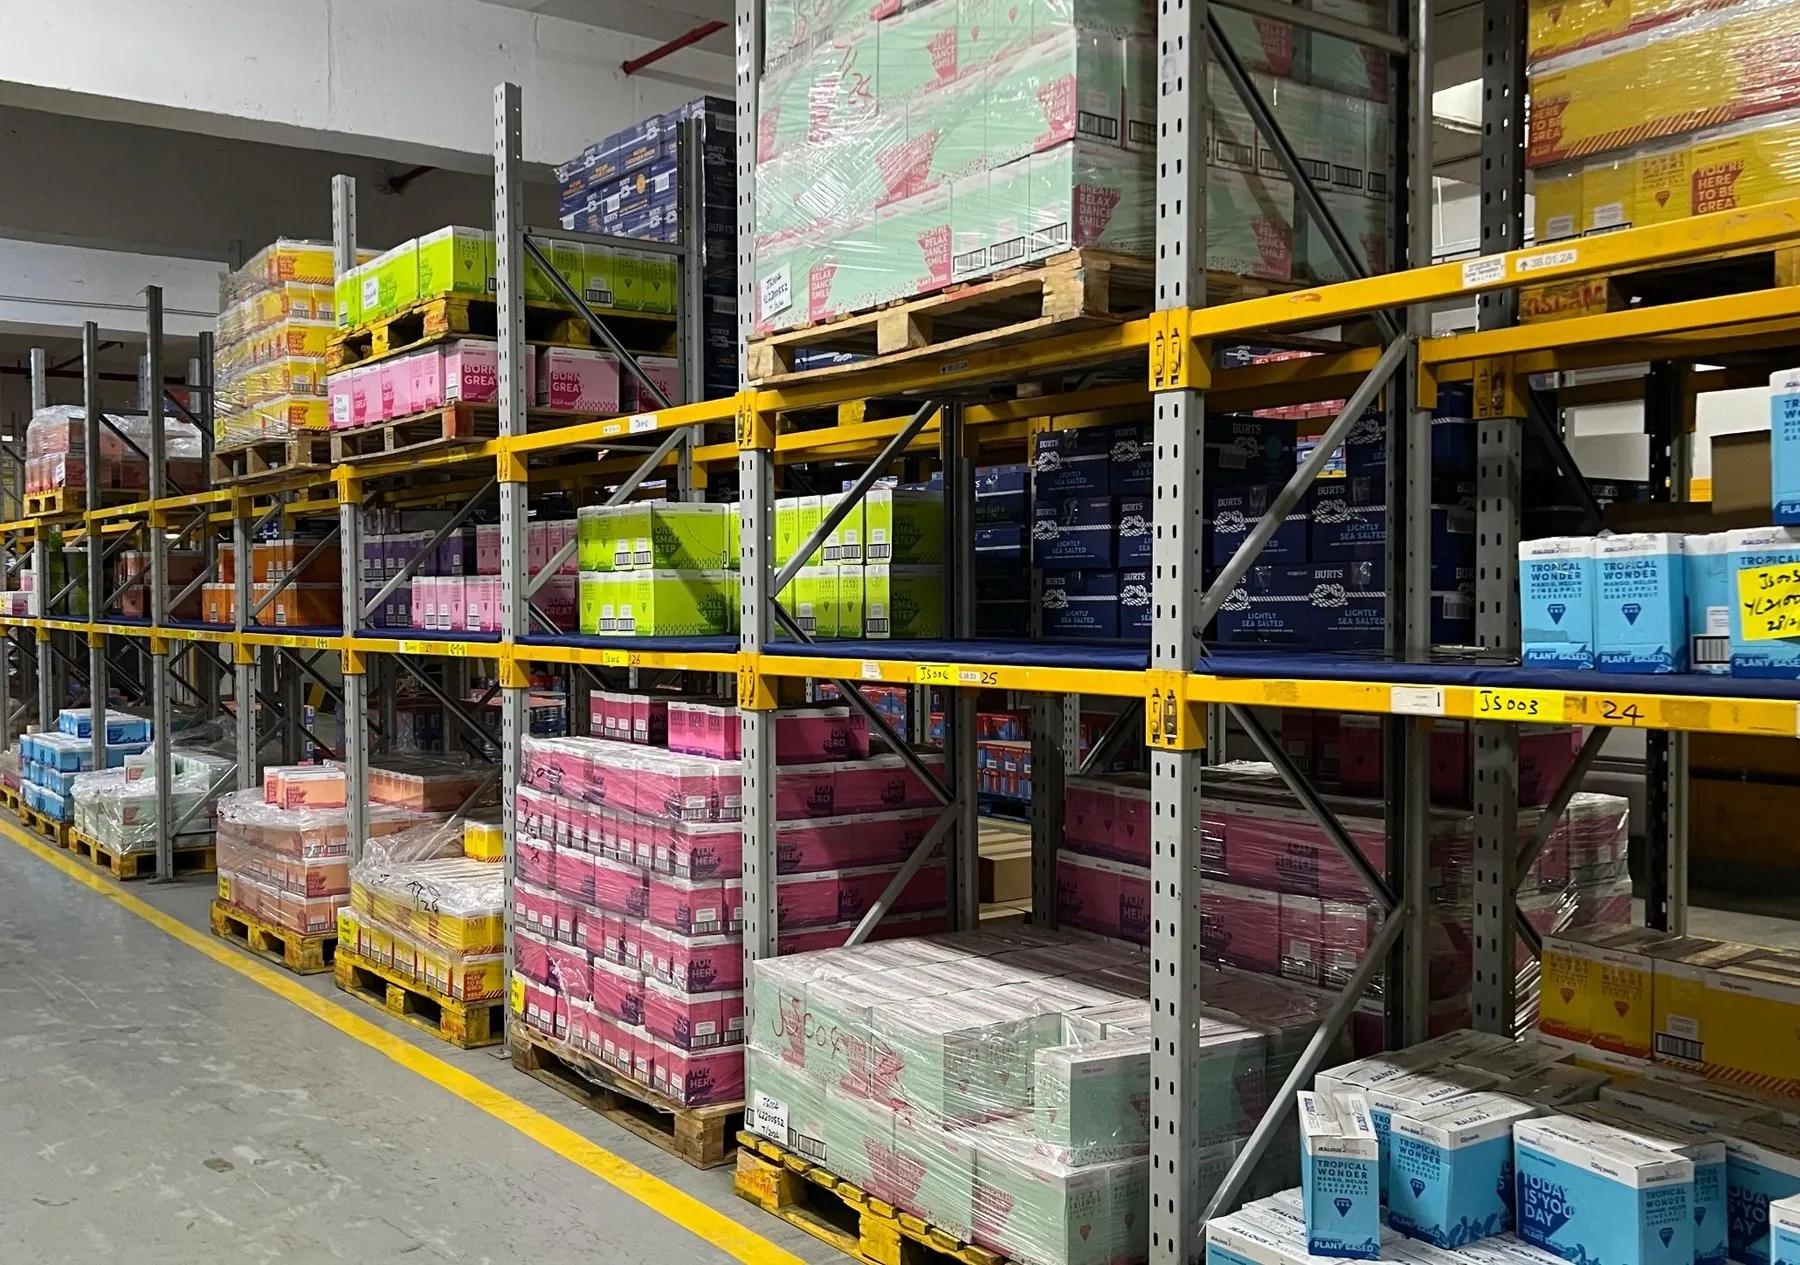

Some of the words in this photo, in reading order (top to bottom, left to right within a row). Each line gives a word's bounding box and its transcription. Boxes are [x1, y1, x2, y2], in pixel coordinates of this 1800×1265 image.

[1698, 173, 1733, 189] HERE
[1080, 193, 1110, 207] RELAX
[1698, 190, 1717, 202] TO
[1079, 215, 1107, 229] SMILE
[707, 224, 735, 234] BURTS
[925, 233, 949, 250] RELAX
[811, 269, 832, 282] RELAX
[464, 364, 496, 374] BORN
[464, 375, 495, 386] GREA
[553, 371, 581, 382] BORN
[1232, 424, 1261, 434] BURTS
[1039, 439, 1058, 449] BURTS
[1317, 485, 1346, 496] BURTS
[1217, 497, 1242, 507] BURTS
[1036, 507, 1057, 516] BURTS
[1121, 503, 1143, 512] BURTS
[1347, 523, 1379, 532] LIGHTLY
[1340, 532, 1356, 540] SEA
[655, 544, 677, 553] STEP
[1067, 546, 1087, 554] SALTED
[1740, 554, 1800, 565] TROPICAL
[1531, 563, 1581, 572] TROPICAL
[1604, 561, 1658, 571] TROPICAL
[1123, 572, 1146, 581] BURTS
[1314, 569, 1343, 579] BURTS
[1531, 572, 1581, 581] WONDER
[1604, 570, 1658, 580] WONDER
[1045, 577, 1066, 585] BURTS
[703, 609, 723, 618] STEP
[1247, 612, 1277, 620] LIGHTLY
[1344, 609, 1378, 617] LIGHTLY
[1074, 616, 1095, 624] SALTED
[1337, 617, 1353, 625] SEA
[1355, 617, 1385, 625] SALTED
[632, 654, 641, 665] 26
[1529, 652, 1556, 660] PLANT
[1559, 652, 1587, 660] BASED
[1602, 655, 1630, 663] PLANT
[1634, 655, 1664, 663] BASED
[1735, 658, 1767, 666] PLANT
[981, 671, 999, 685] 25
[1480, 690, 1538, 715] JS003
[1602, 700, 1645, 727] 24
[691, 959, 713, 970] YOU
[1400, 1138, 1441, 1158] TROPICAL
[1399, 1145, 1440, 1165] WONDER
[1317, 1160, 1368, 1171] TROPICAL
[1317, 1168, 1368, 1179] WONDER
[1317, 1182, 1368, 1190] PINEAPPLE
[1523, 1173, 1569, 1199] TODAY
[1317, 1187, 1368, 1196] GRAPEFRUIT
[1646, 1187, 1686, 1199] TROPICAL
[1646, 1196, 1687, 1208] WONDER
[1525, 1203, 1554, 1227] DAY
[1314, 1241, 1341, 1250] PLANT
[1345, 1243, 1373, 1252] BASED
